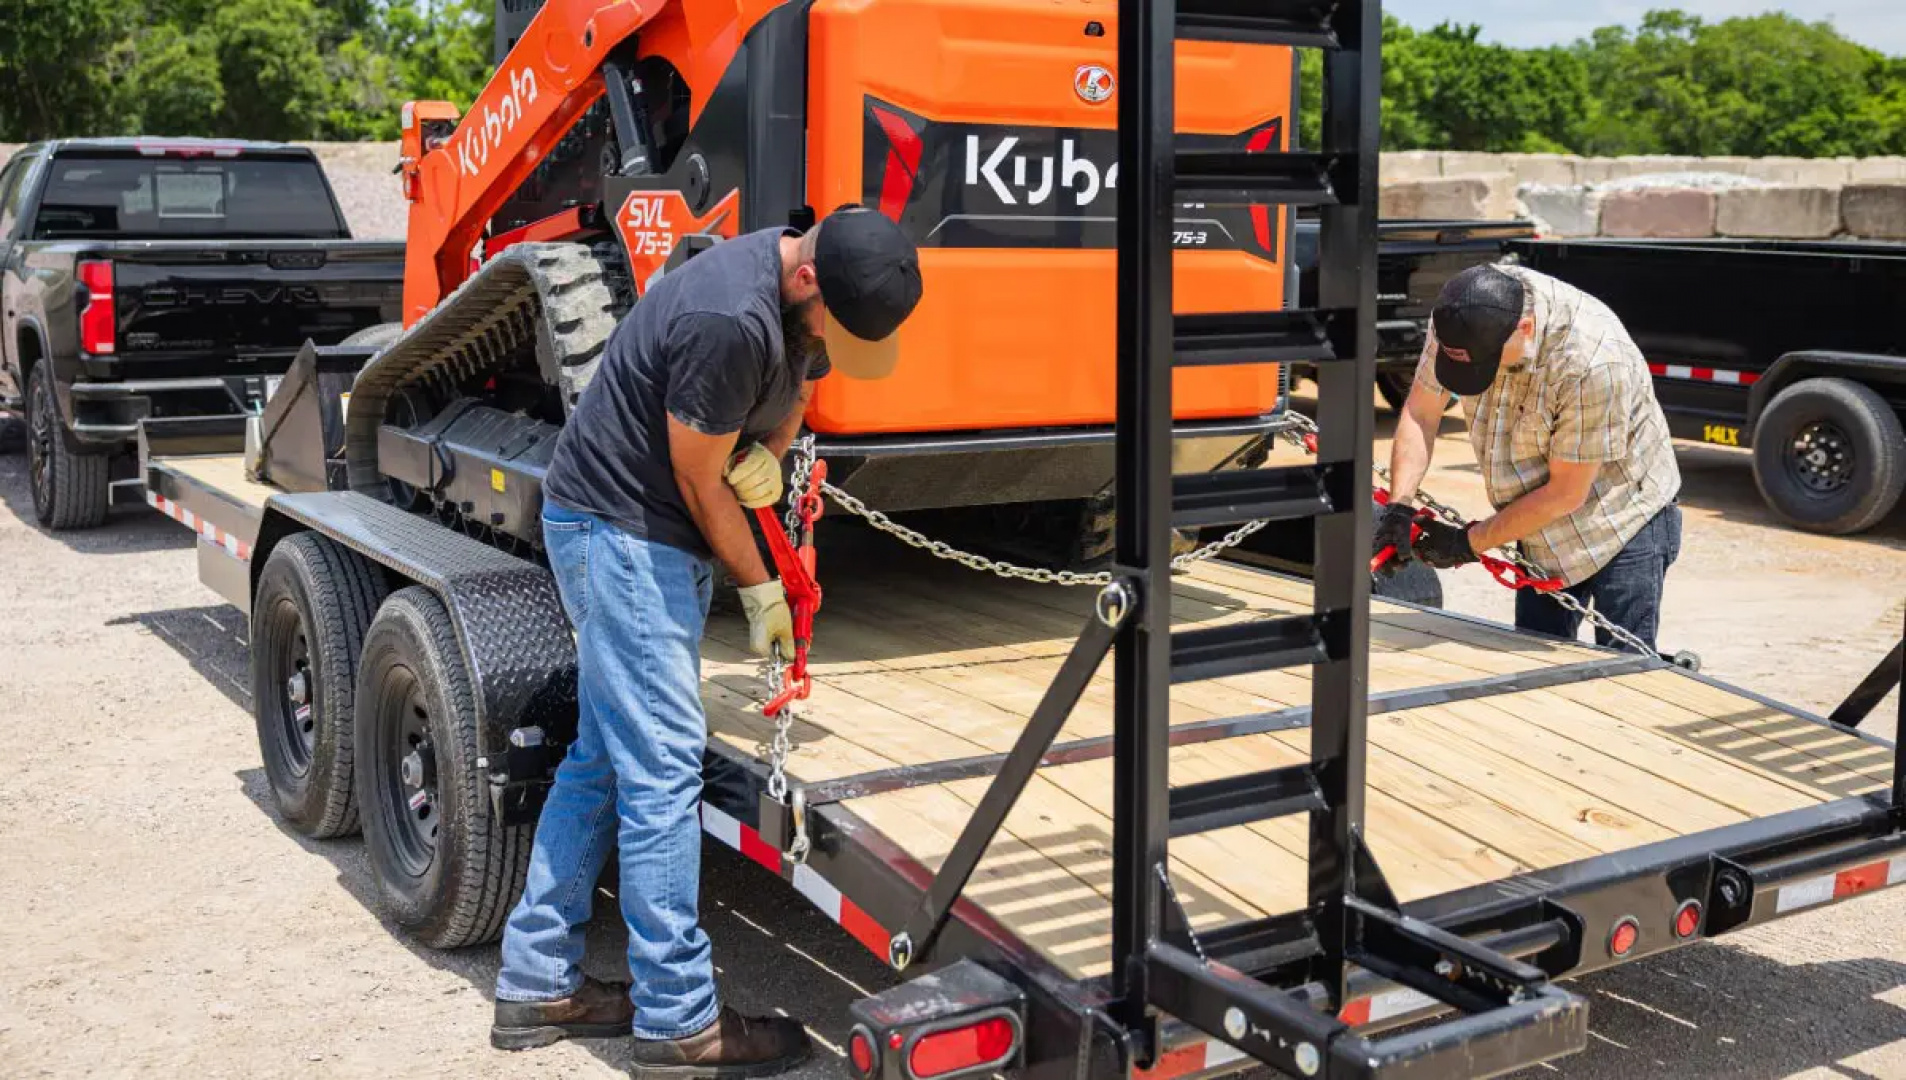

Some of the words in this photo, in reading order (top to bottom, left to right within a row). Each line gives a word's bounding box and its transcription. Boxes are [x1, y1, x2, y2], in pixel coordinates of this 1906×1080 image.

[458, 67, 538, 175] Kubota
[965, 135, 1118, 206] Kub
[627, 198, 671, 228] SVL
[634, 231, 673, 256] 75-3
[1172, 231, 1207, 244] 75-3
